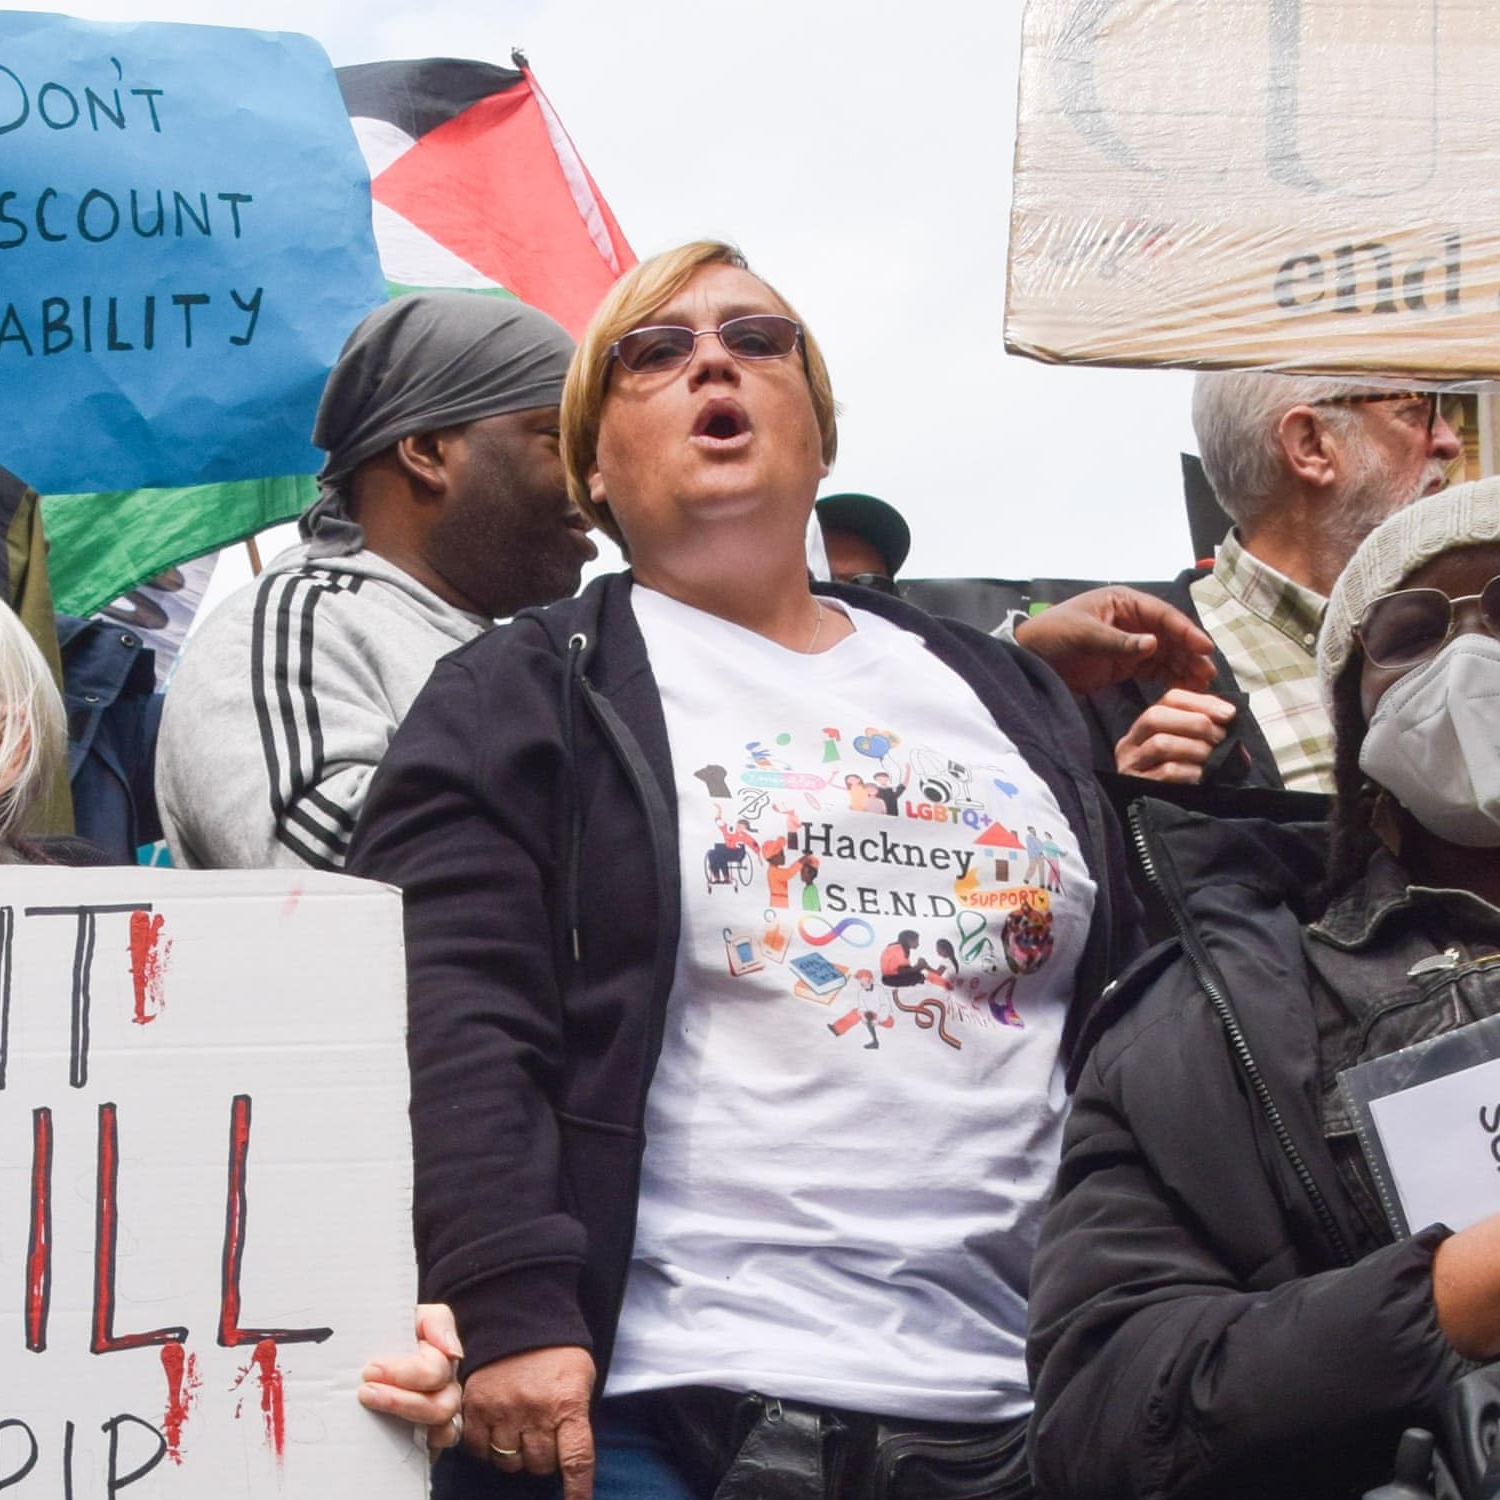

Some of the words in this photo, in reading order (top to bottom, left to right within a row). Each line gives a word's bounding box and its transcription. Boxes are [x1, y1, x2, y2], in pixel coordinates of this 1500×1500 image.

[1273, 230, 1463, 315] end
[906, 802, 993, 831] LGBTQ+
[801, 821, 975, 880] Hackney
[825, 883, 957, 919] S.E.N.D
[970, 888, 1039, 908] SUPPORT
